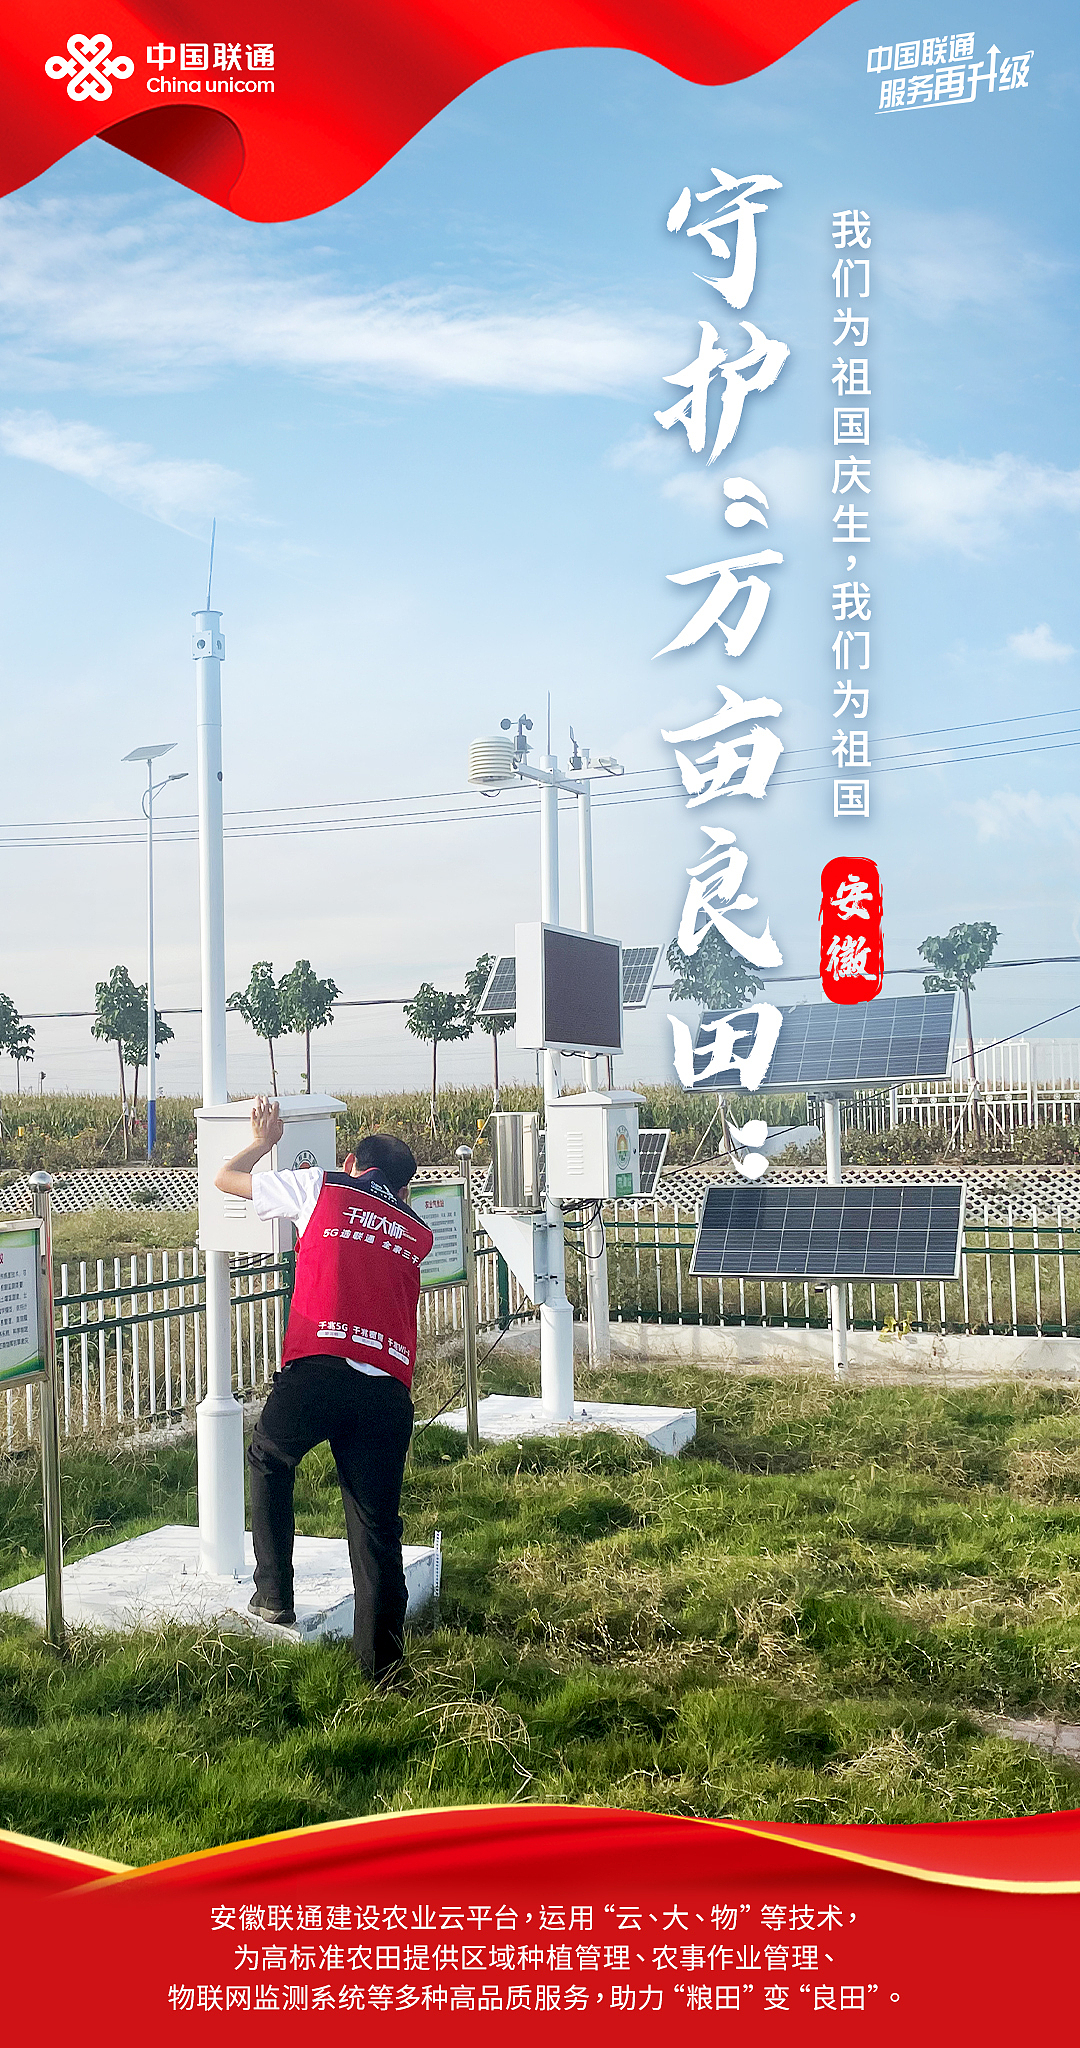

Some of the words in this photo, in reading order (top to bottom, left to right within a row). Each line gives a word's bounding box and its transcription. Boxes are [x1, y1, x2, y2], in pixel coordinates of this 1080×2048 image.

[342, 1206, 408, 1240] 千兆大师
[381, 1240, 421, 1268] 全家三千
